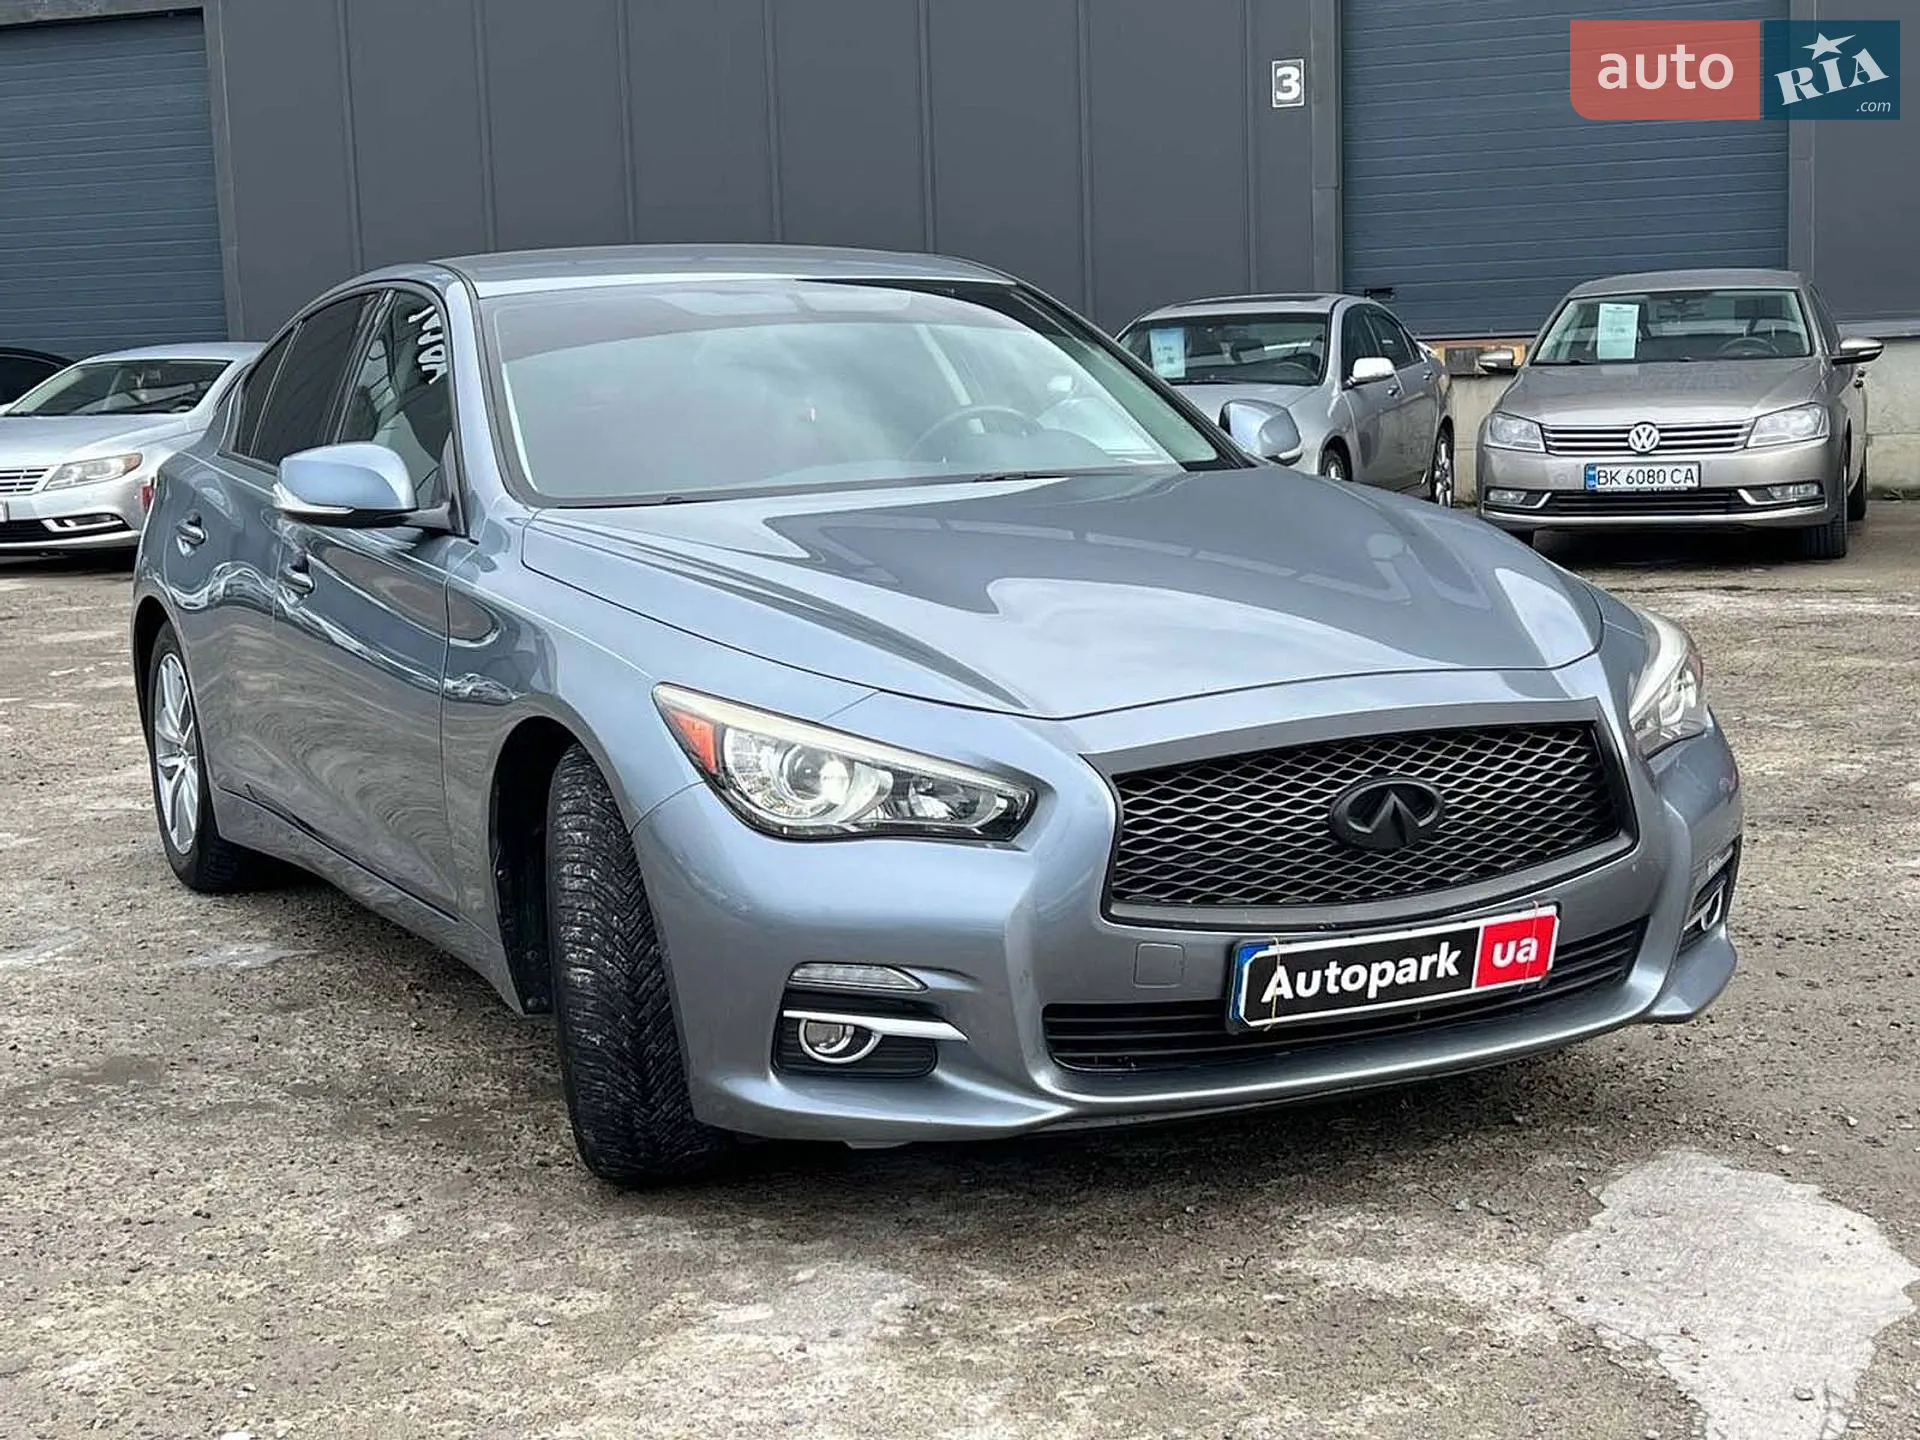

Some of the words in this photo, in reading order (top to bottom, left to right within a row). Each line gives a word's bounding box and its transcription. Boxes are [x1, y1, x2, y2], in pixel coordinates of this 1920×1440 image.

[1276, 66, 1301, 100] 3
[1597, 469, 1621, 486] BK
[1626, 468, 1667, 485] 6080
[1670, 468, 1696, 484] CA
[1261, 941, 1462, 1003] Autopark
[1491, 936, 1540, 968] ua
